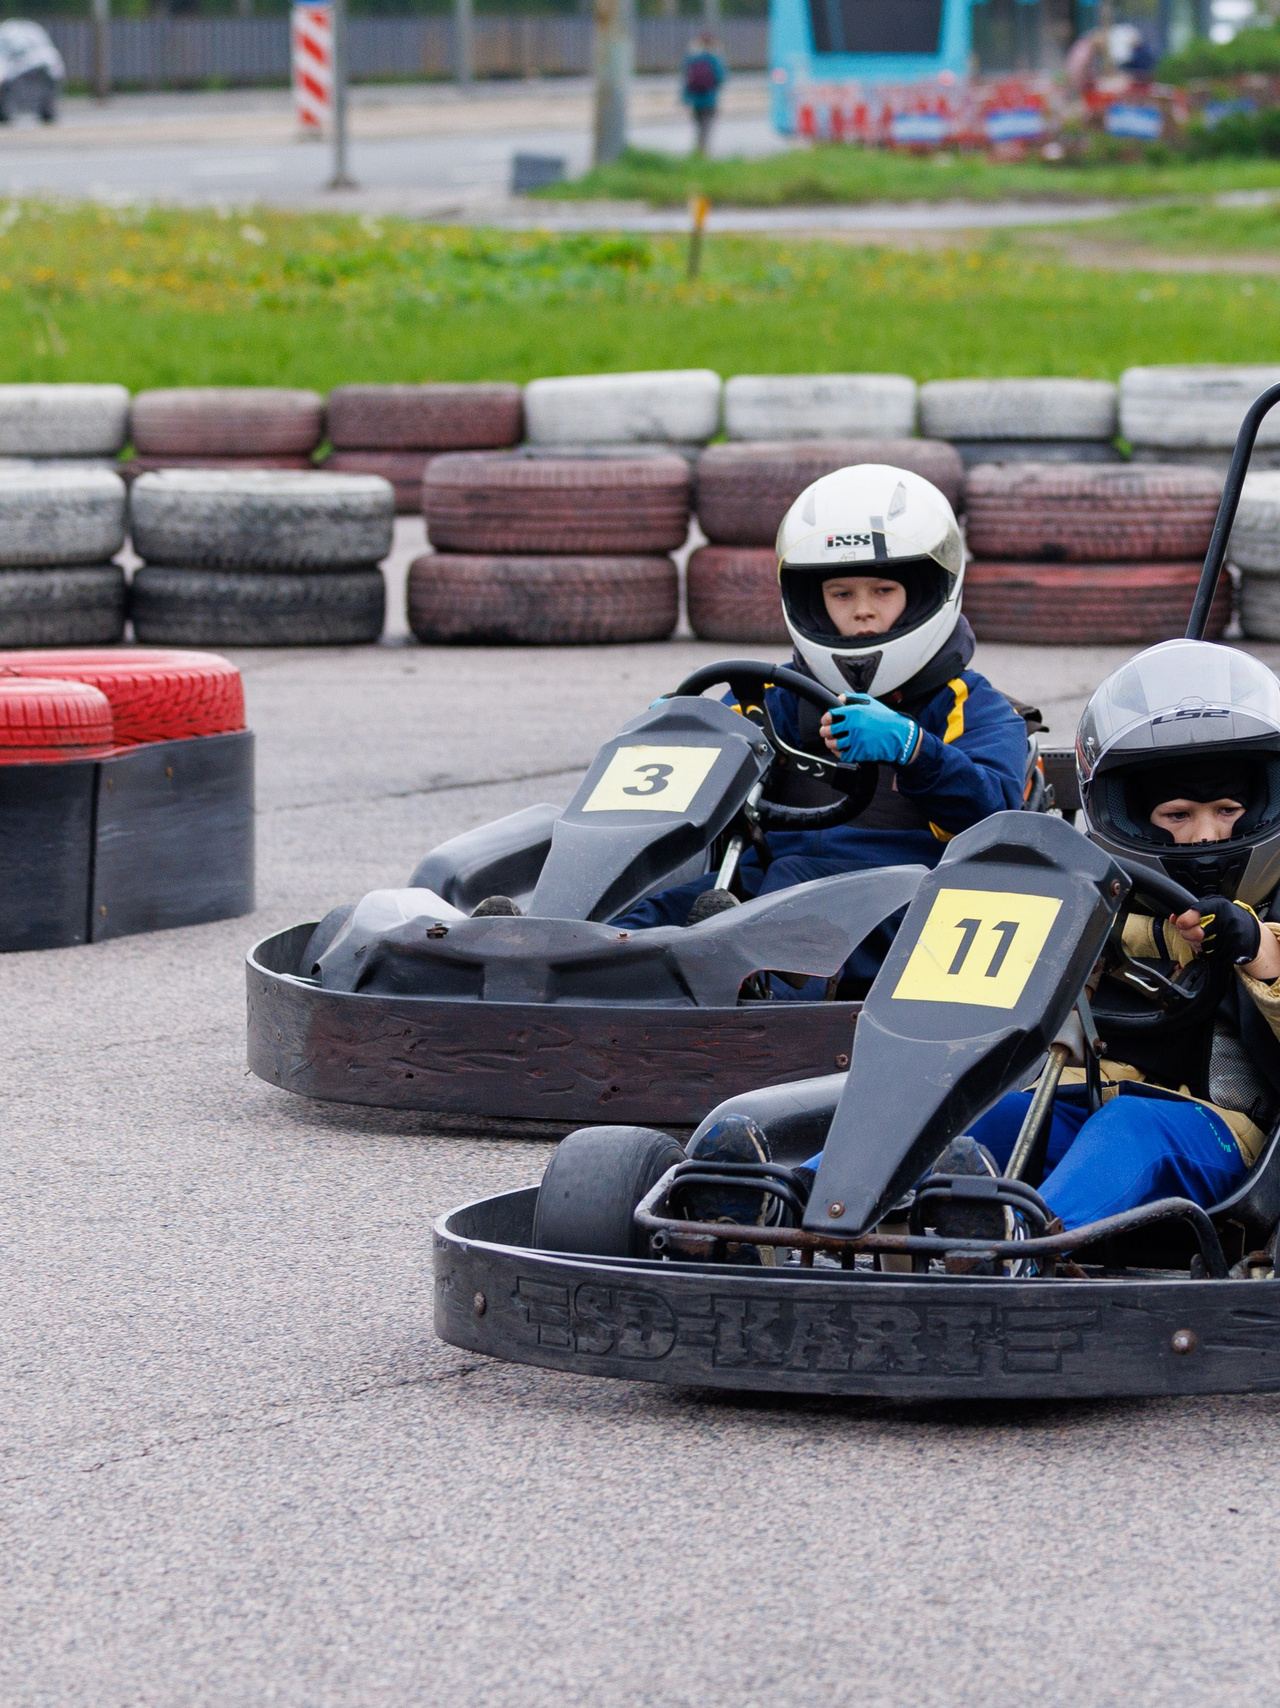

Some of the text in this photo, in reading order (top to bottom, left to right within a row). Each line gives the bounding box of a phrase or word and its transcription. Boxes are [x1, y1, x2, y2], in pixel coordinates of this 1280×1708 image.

[1151, 709, 1230, 726] LS2
[622, 763, 674, 796] 3
[947, 918, 1020, 978] 11
